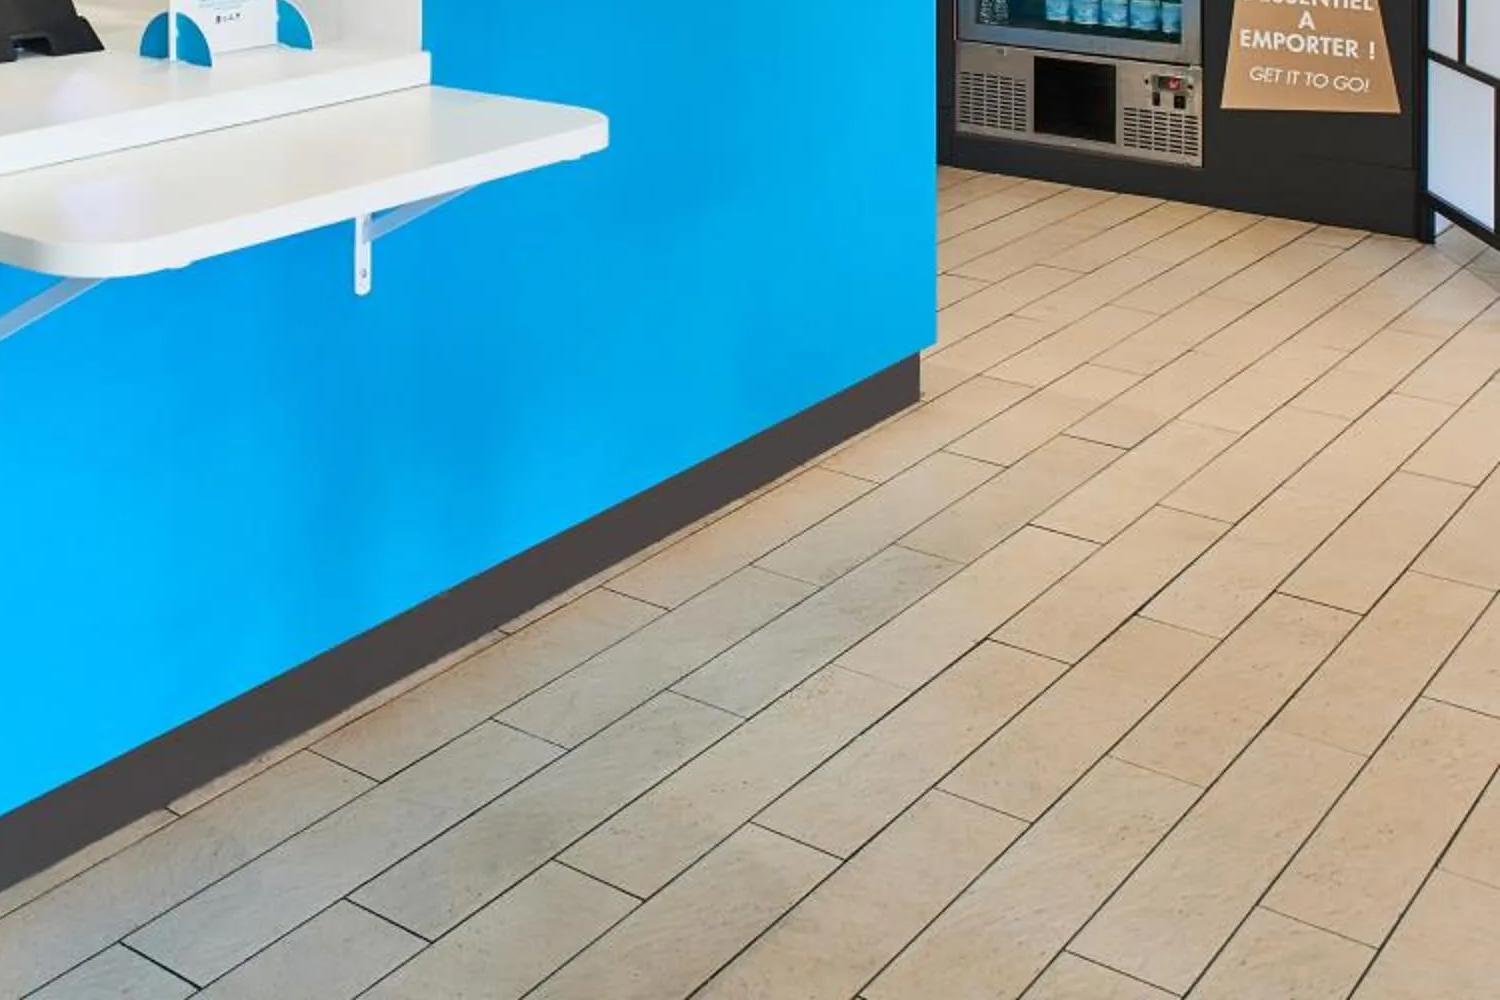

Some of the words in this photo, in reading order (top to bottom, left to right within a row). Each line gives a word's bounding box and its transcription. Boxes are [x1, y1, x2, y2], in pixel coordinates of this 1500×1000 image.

[1298, 10, 1316, 30] A
[1239, 29, 1360, 59] EMPORTER
[1249, 66, 1284, 83] GET
[1286, 69, 1300, 85] IT
[1304, 71, 1329, 88] TO
[1333, 74, 1371, 93] GO!
